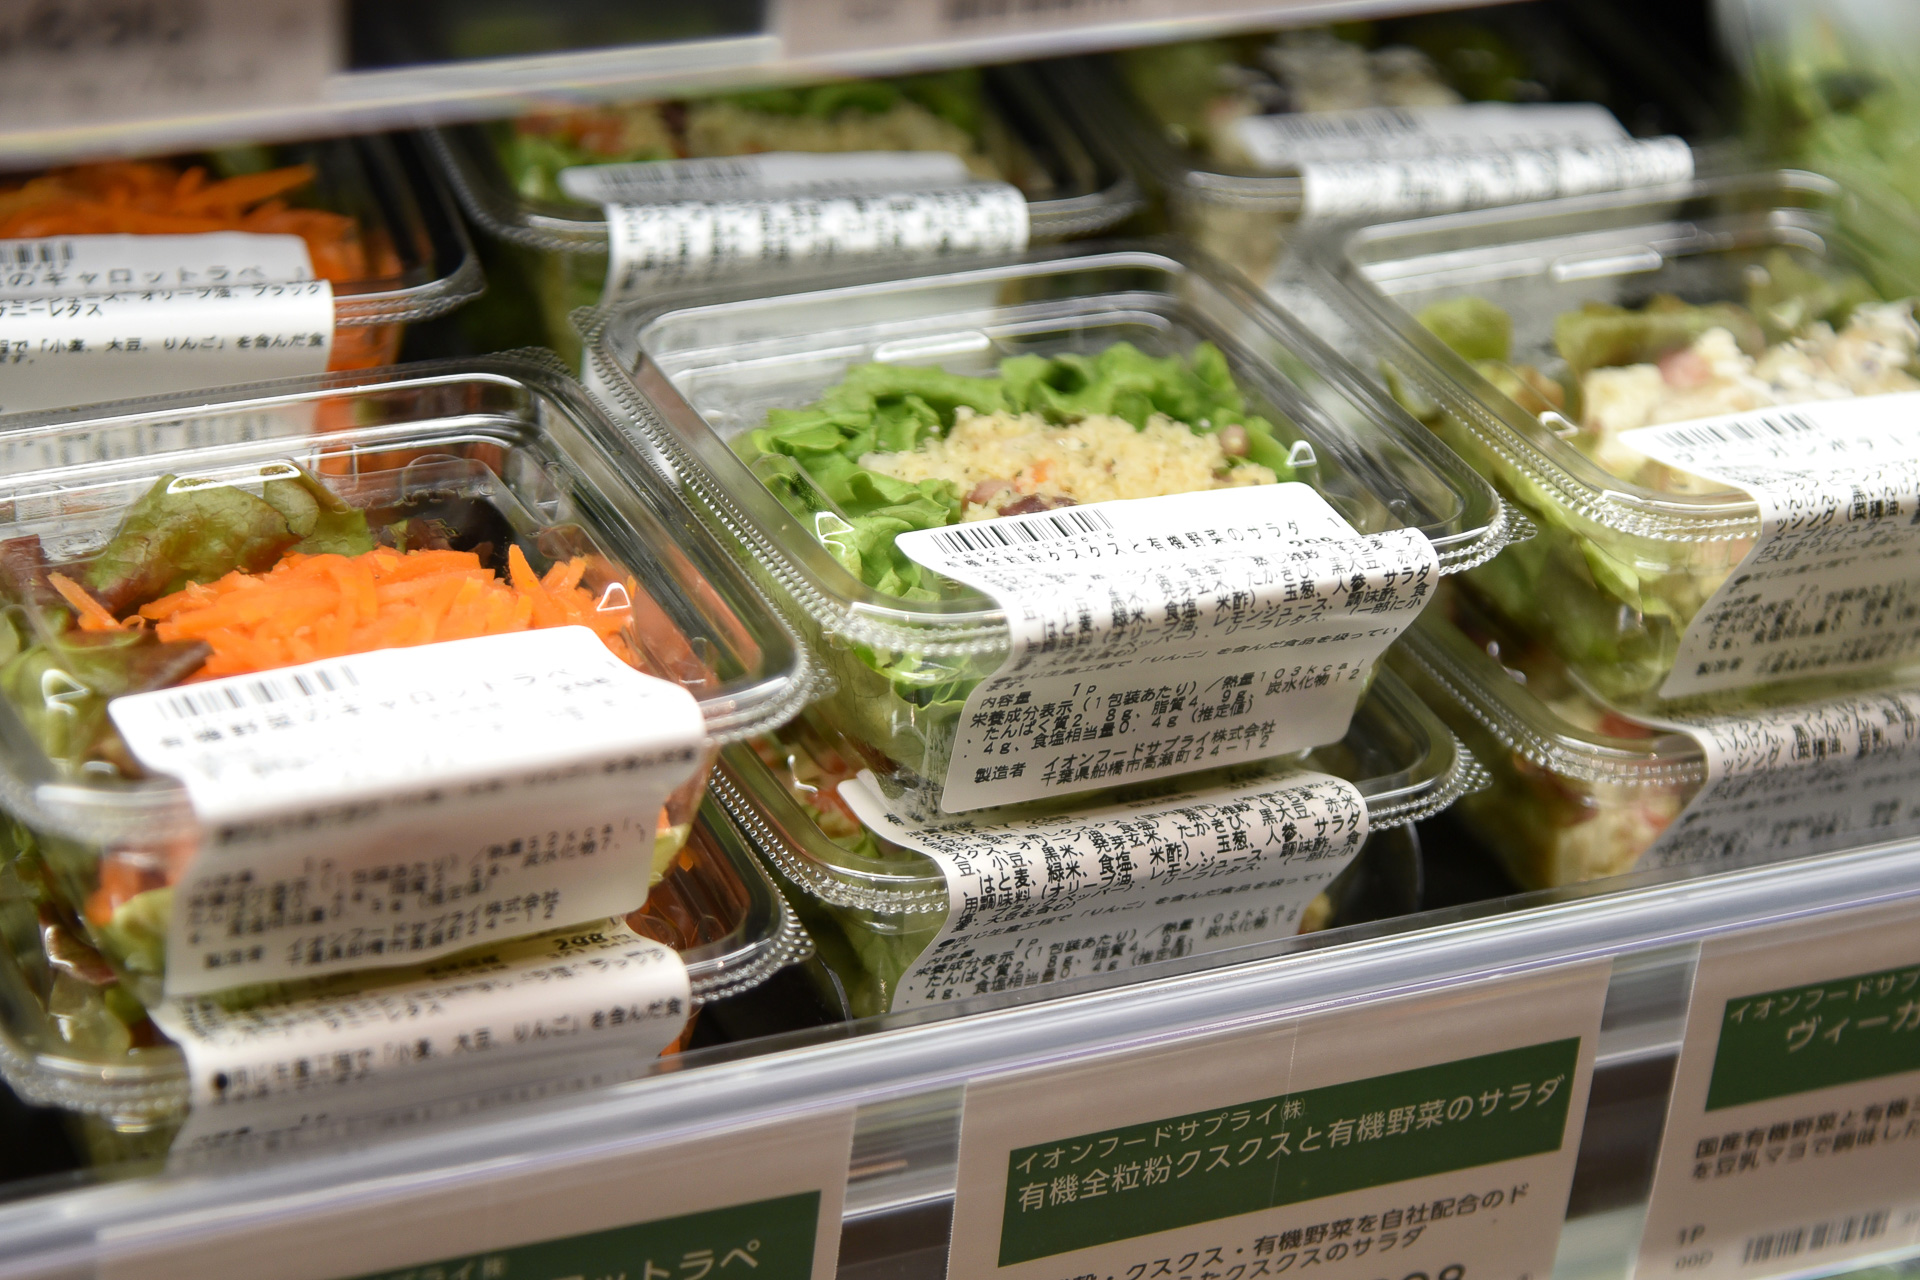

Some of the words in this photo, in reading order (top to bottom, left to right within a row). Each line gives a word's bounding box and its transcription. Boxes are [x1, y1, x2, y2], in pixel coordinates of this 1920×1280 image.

[0, 265, 267, 287] のキャロットラペ
[979, 690, 1032, 710] 内容量
[973, 761, 1027, 784] 製造者
[1044, 719, 1276, 774] イオンフードサプライ株式会社
[1018, 1073, 1566, 1213] 有機全粒粉クスクスと有機野菜のサラダ
